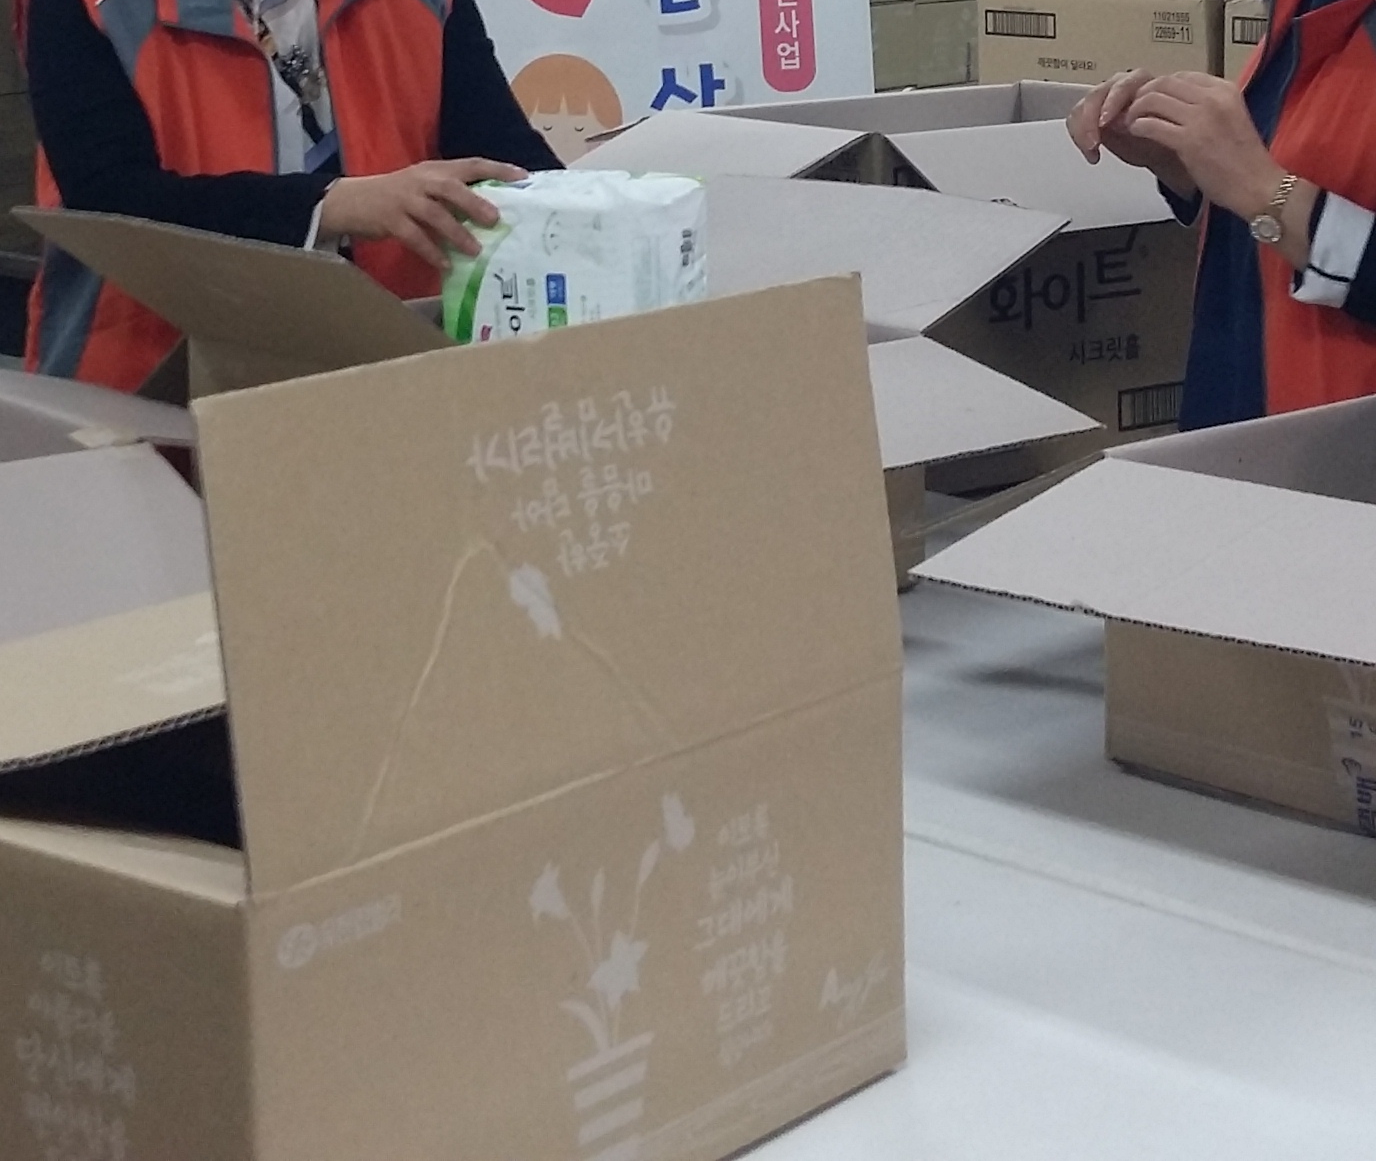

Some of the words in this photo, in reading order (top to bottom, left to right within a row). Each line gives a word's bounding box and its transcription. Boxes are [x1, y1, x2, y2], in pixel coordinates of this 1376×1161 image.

[494, 272, 525, 336] 이트
[465, 385, 677, 484] 유한킴벌리가
[510, 477, 572, 532] 담아
[576, 463, 653, 520] 마음을
[556, 520, 631, 578] 소중한
